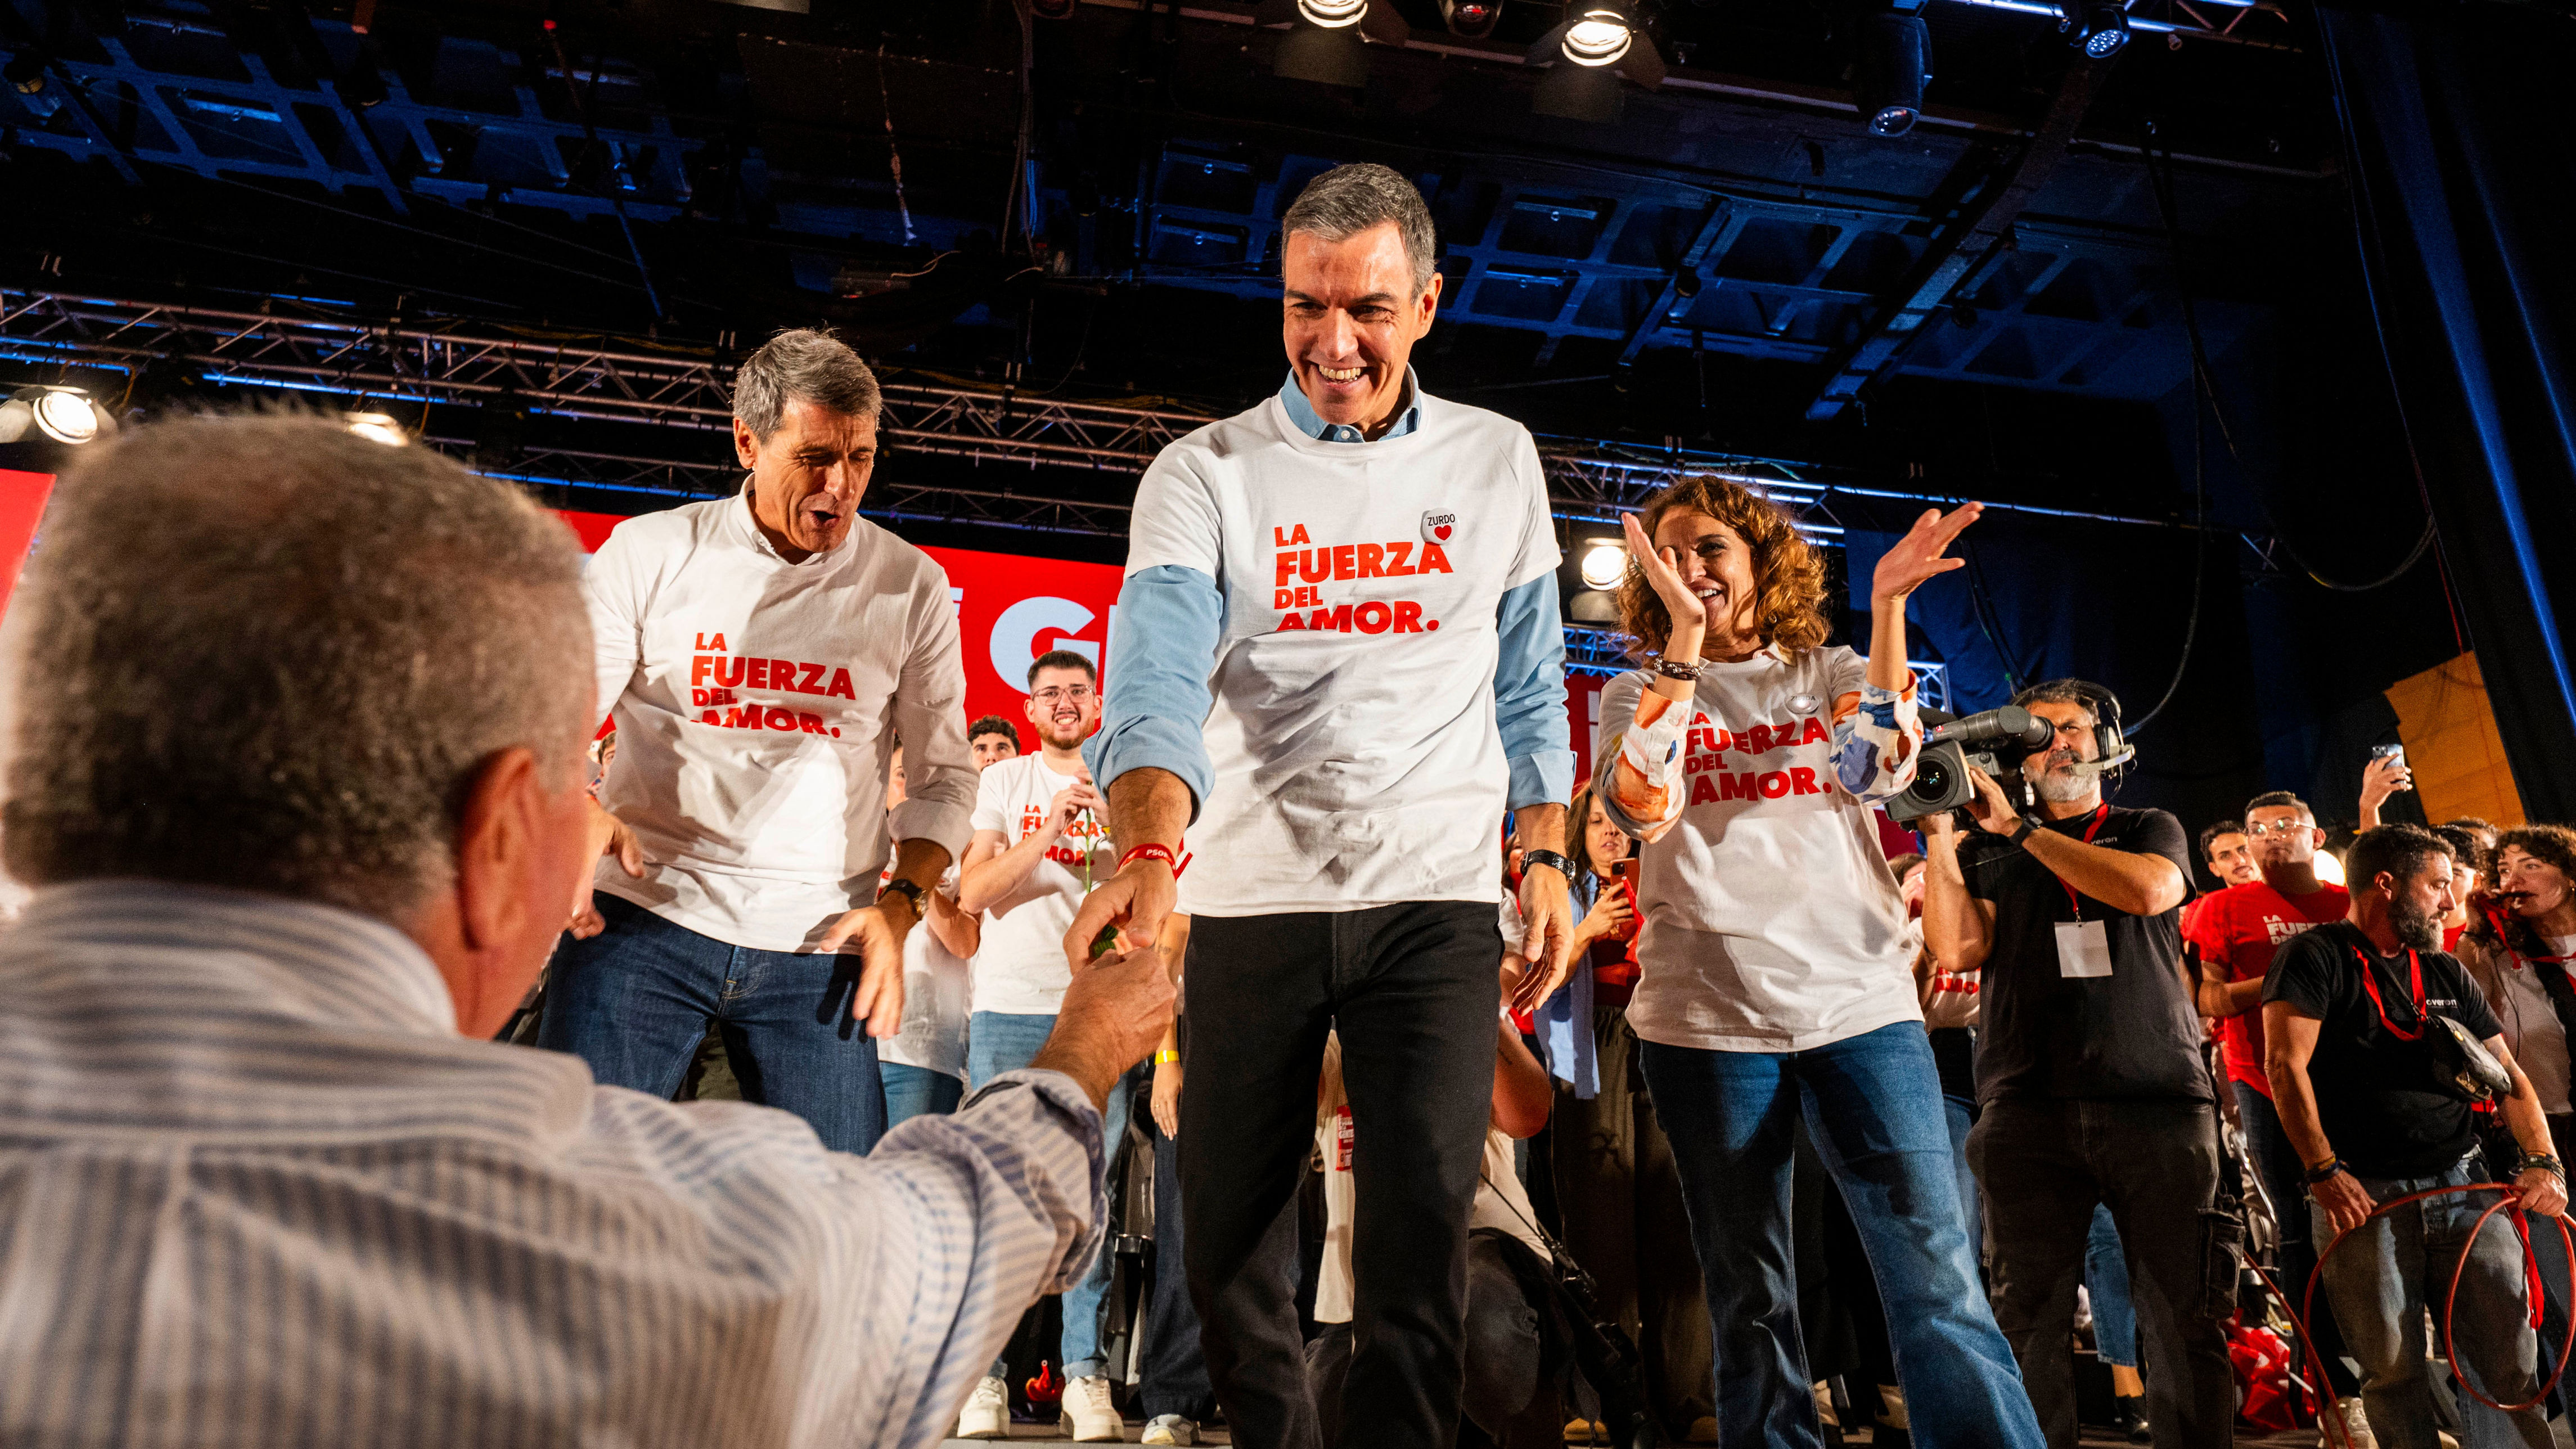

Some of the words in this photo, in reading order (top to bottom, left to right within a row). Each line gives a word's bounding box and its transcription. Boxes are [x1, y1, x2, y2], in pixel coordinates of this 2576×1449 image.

[1427, 514, 1456, 526] ZURDO
[1274, 524, 1310, 547] LA
[1275, 541, 1454, 587] FUERZA
[1274, 586, 1323, 610] DEL
[1275, 601, 1440, 634] AMOR.
[695, 633, 727, 651] LA
[691, 655, 856, 700] FUERZA
[691, 688, 737, 706] DEL
[1688, 712, 1711, 726] A
[1685, 717, 1830, 757] FUERZA
[1686, 753, 1728, 775] DEL
[1690, 766, 1832, 807] AMOR.
[1025, 804, 1041, 814] LA
[2091, 836, 2118, 845] veron
[1045, 845, 1095, 867] MOR.
[2263, 914, 2282, 924] LA
[1935, 977, 1980, 995] AMO
